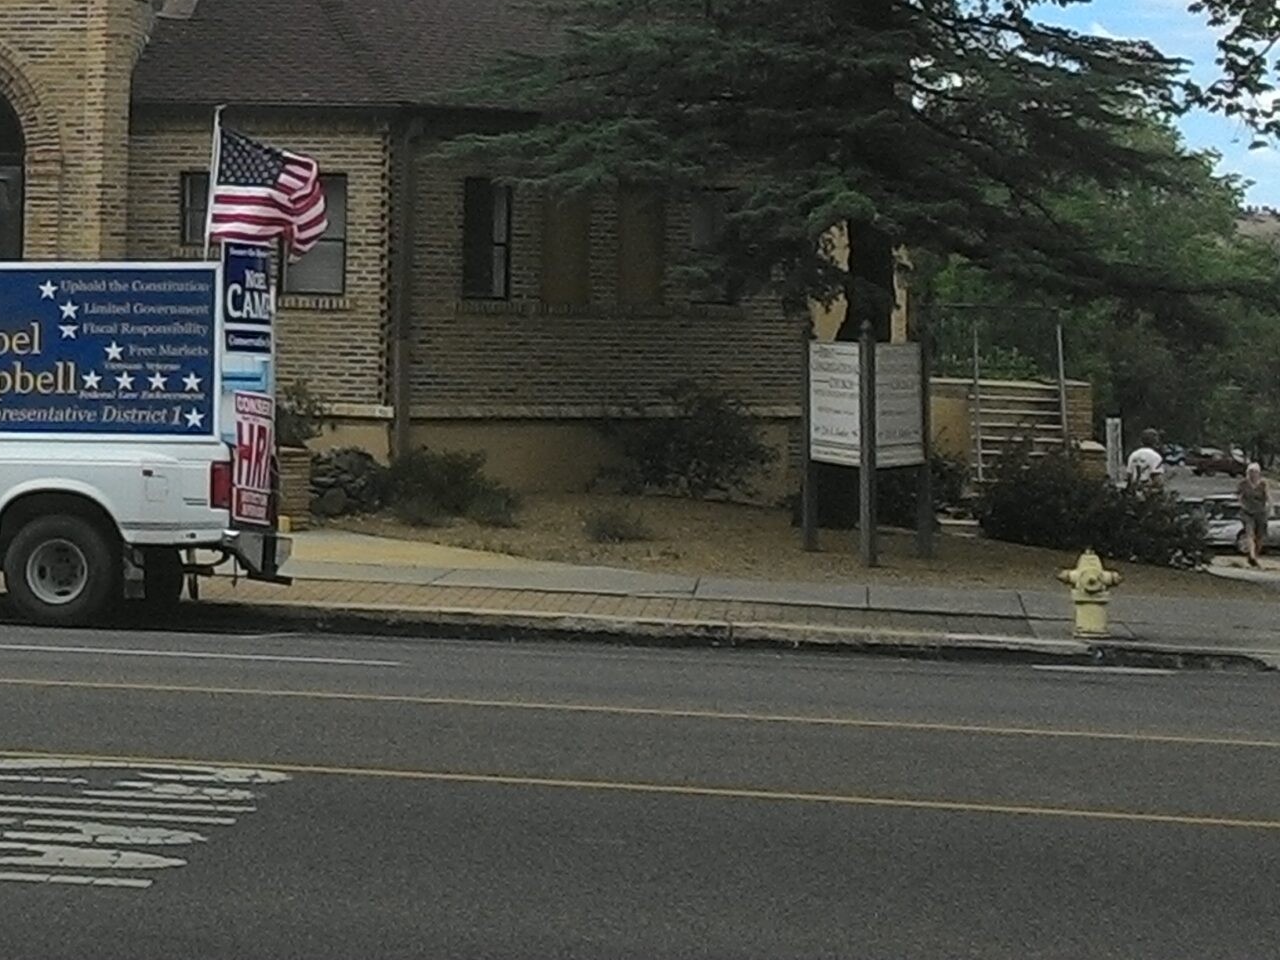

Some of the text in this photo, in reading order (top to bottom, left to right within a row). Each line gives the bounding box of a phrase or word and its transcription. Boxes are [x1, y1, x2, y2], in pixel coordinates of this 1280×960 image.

[60, 280, 210, 293] Uphold the Constitution
[84, 302, 209, 315] Limited Government
[83, 323, 208, 337] Fiscal Responsibility
[129, 344, 208, 357] Free Markets
[102, 405, 168, 423] District
[171, 405, 182, 426] 1
